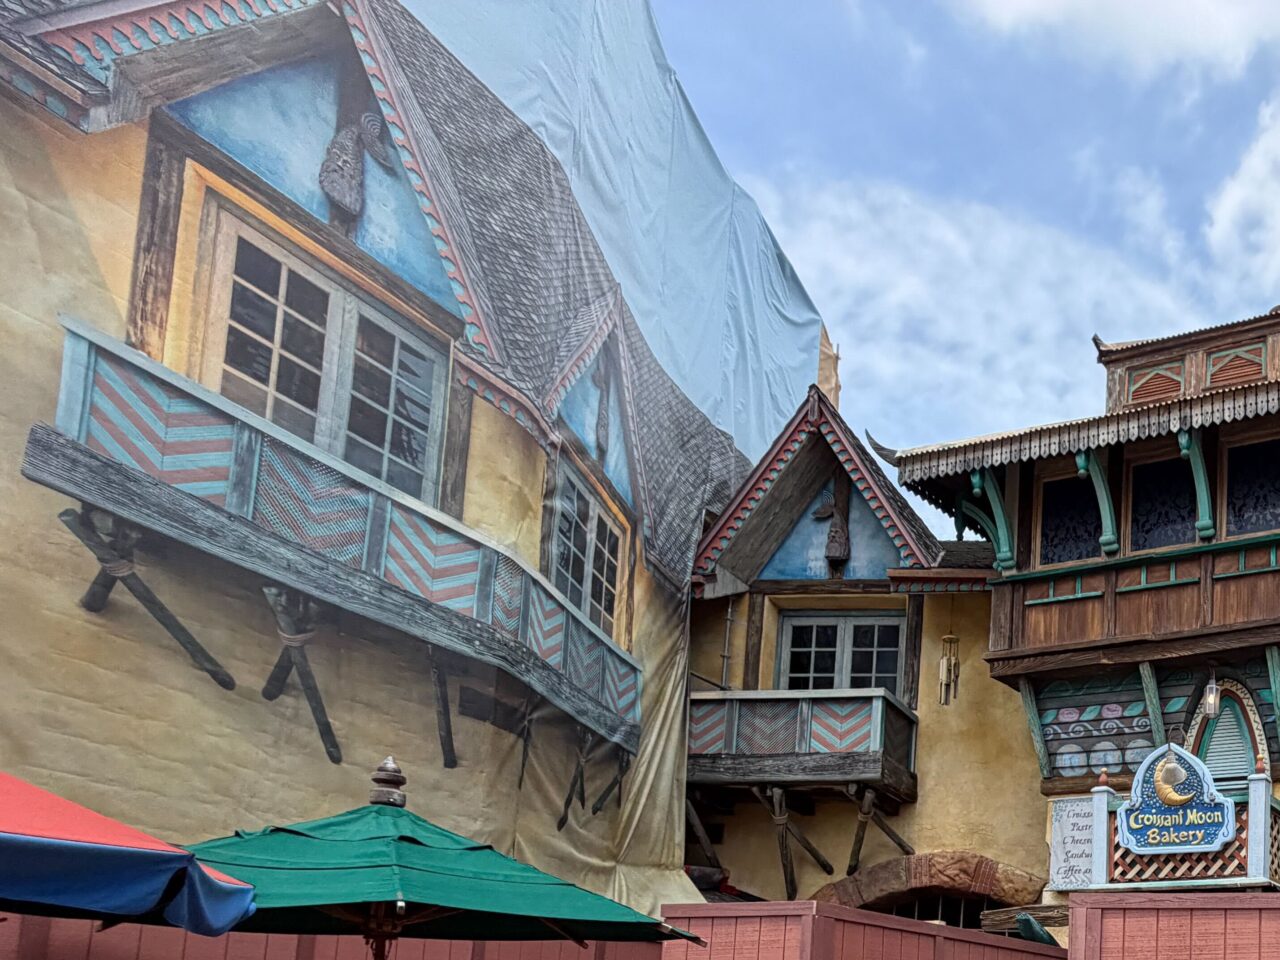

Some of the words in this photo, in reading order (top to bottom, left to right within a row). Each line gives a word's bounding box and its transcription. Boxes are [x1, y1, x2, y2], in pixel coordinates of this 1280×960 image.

[1129, 810, 1184, 829] Croissant
[1185, 808, 1223, 825] Moon
[1147, 828, 1205, 845] Bakery
[1057, 865, 1082, 879] Coffee
